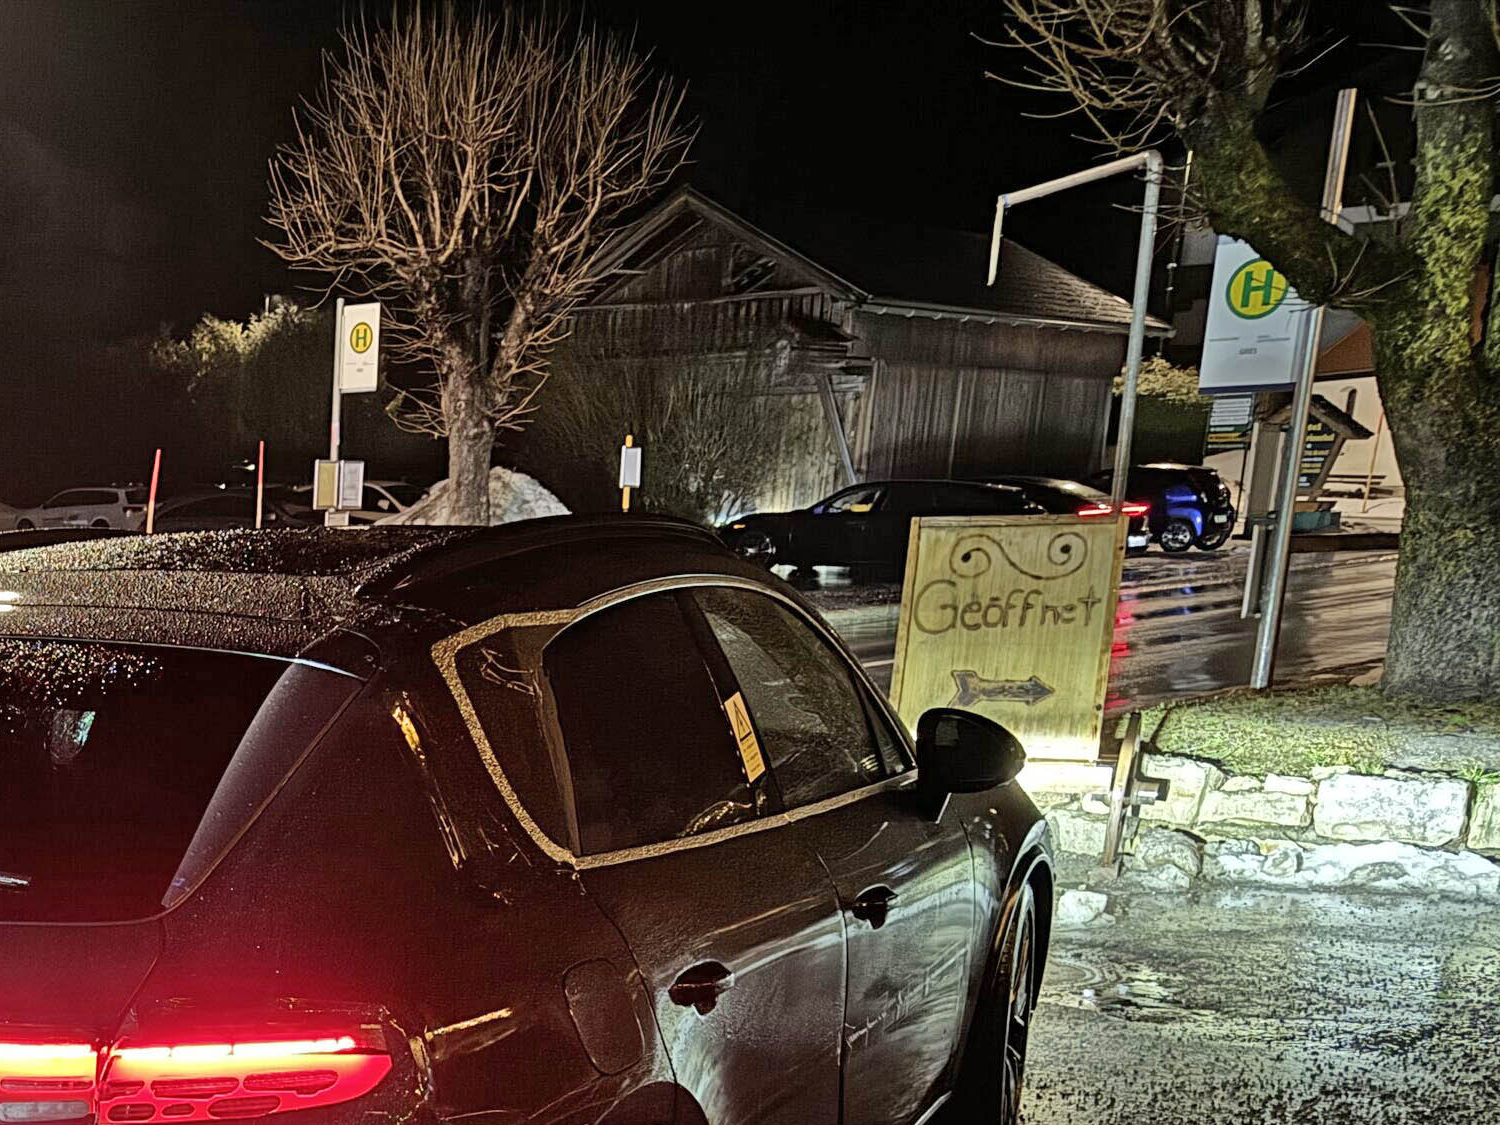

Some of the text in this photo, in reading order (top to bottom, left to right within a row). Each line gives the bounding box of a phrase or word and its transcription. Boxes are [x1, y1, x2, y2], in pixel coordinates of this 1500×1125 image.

[1240, 268, 1275, 308] H
[355, 327, 368, 350] H
[913, 578, 1103, 635] Geöffnet
